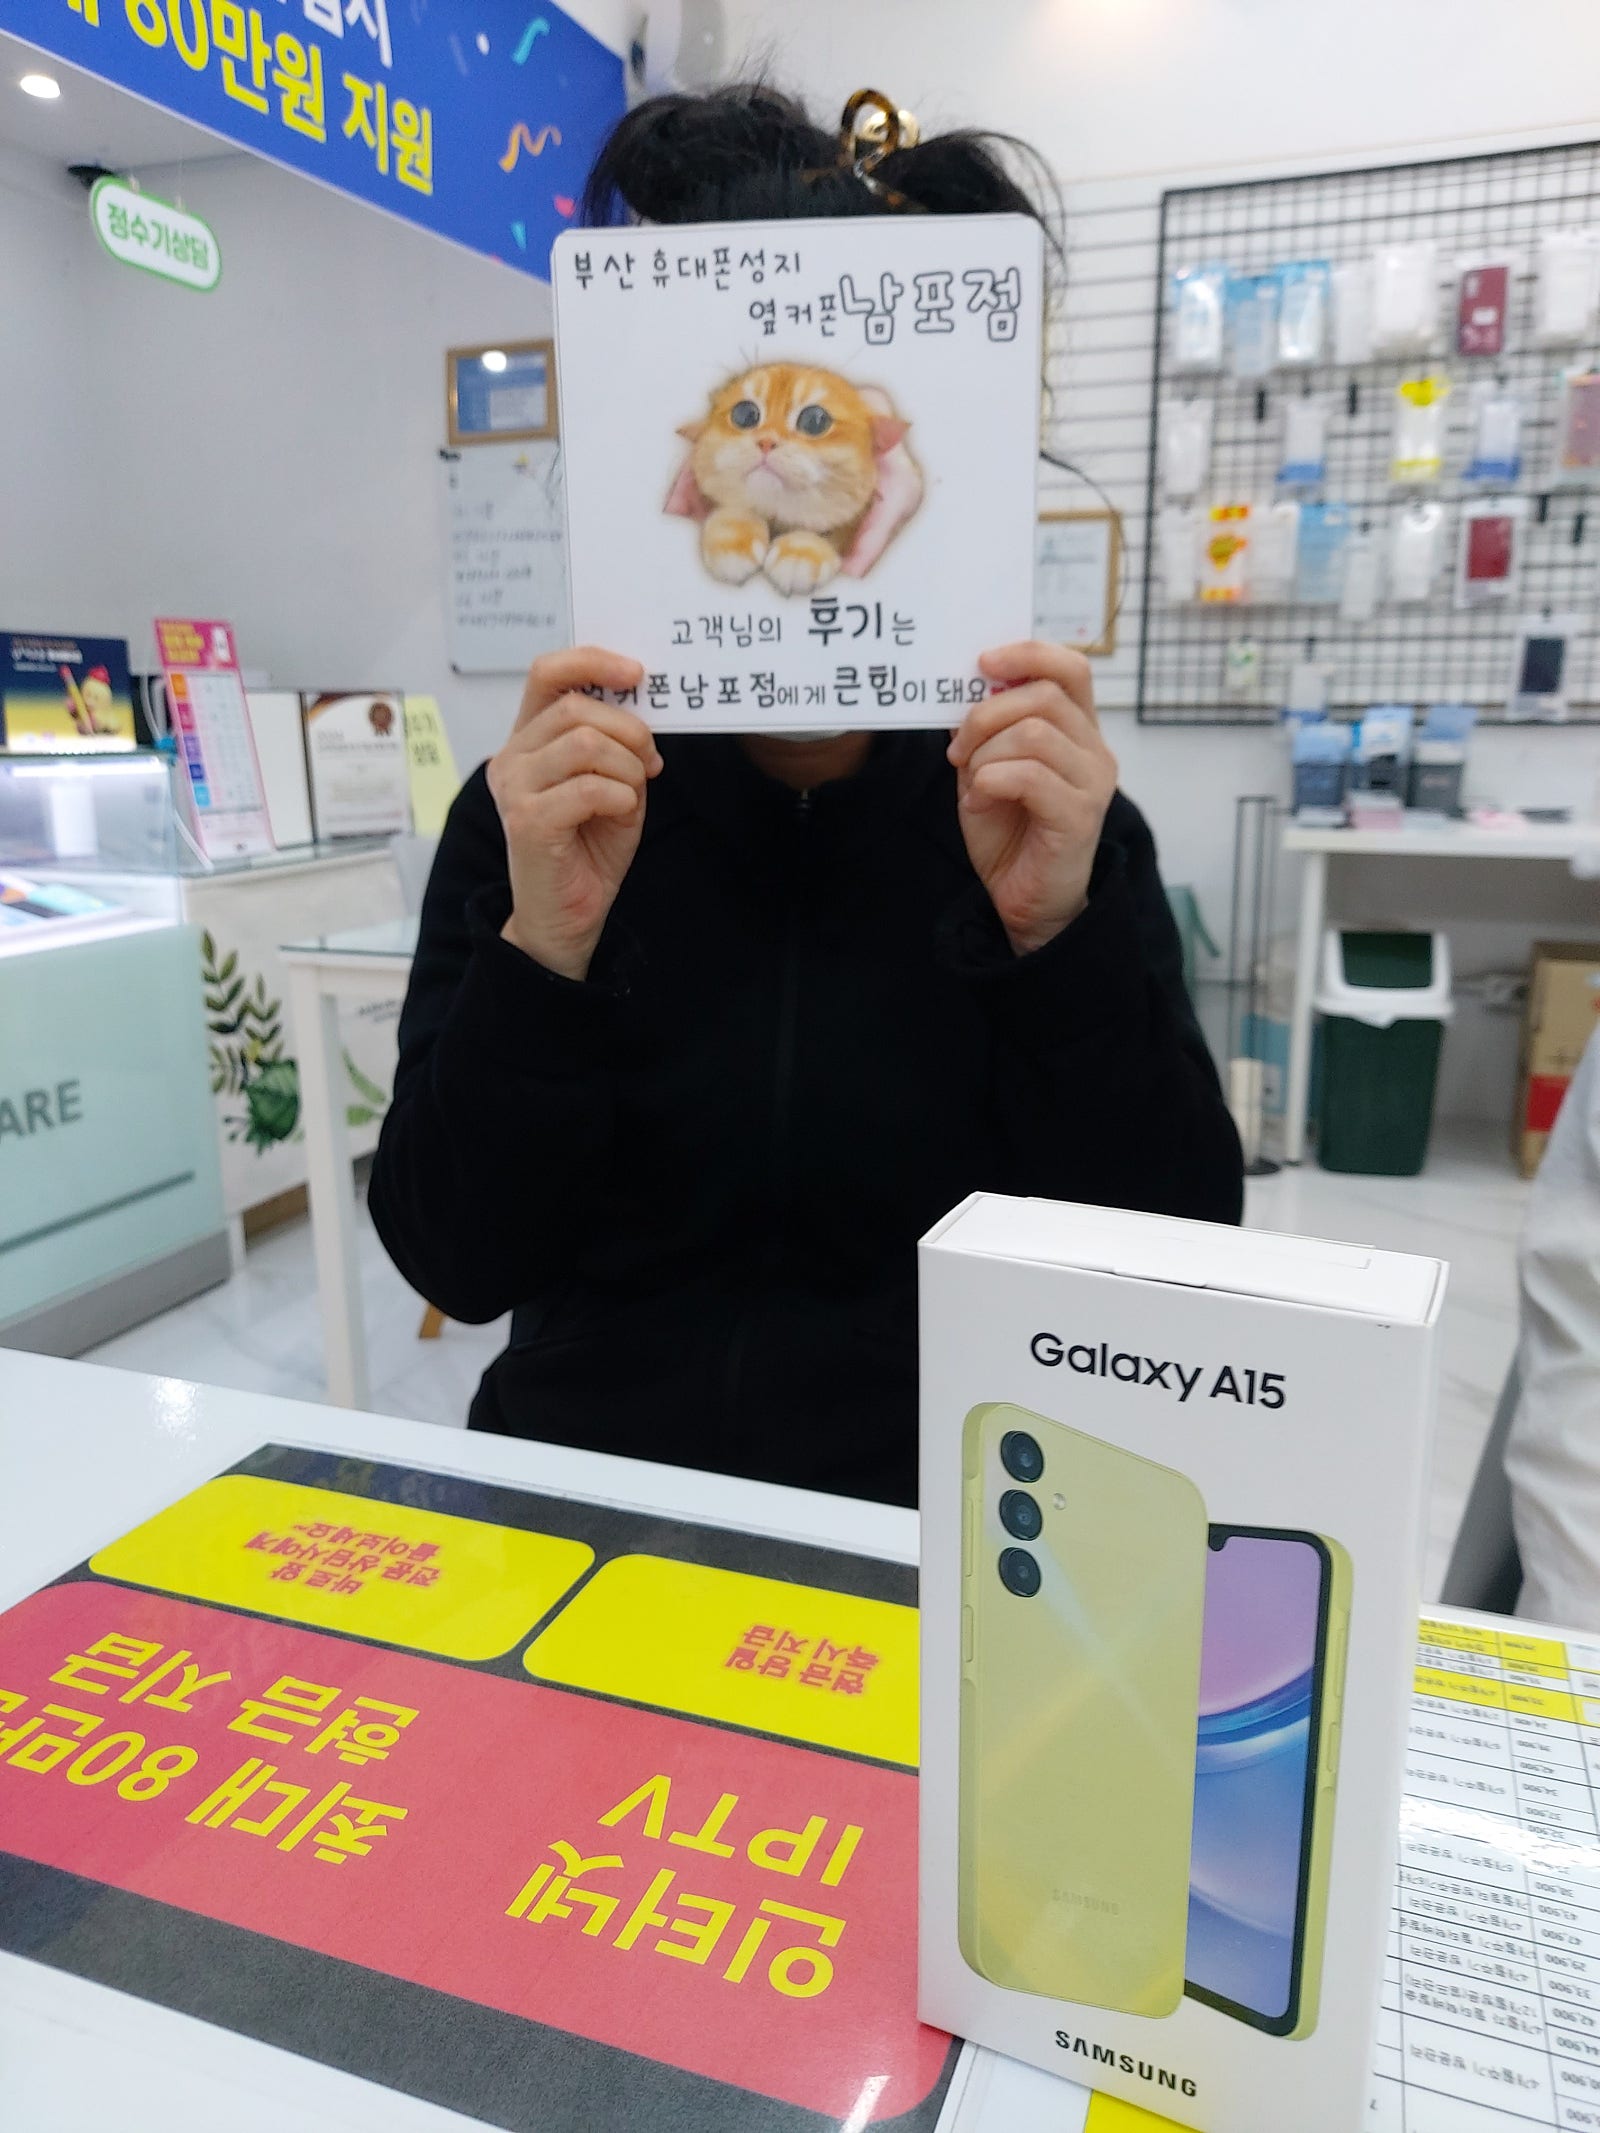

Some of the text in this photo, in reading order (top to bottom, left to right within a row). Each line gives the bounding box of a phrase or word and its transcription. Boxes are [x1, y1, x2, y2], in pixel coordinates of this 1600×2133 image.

[342, 72, 433, 195] 지원
[574, 247, 802, 292] 부산 휴대폰성지
[671, 597, 916, 648] 고객님의 후기는
[936, 677, 988, 706] 돼요
[1030, 1331, 1287, 1410] Galaxy A15
[243, 1531, 381, 1574] 상담사에게
[724, 1646, 865, 1695] 현금 당일
[742, 1624, 879, 1671] 즉시 지급
[48, 1631, 420, 1766] 현금 지급
[184, 1757, 409, 1866] 최대
[594, 1773, 866, 1888] IPTV
[503, 1838, 848, 2000] 인터넷
[1054, 2030, 1198, 2099] SAMSUNG
[1410, 2044, 1466, 2072] 방문관리
